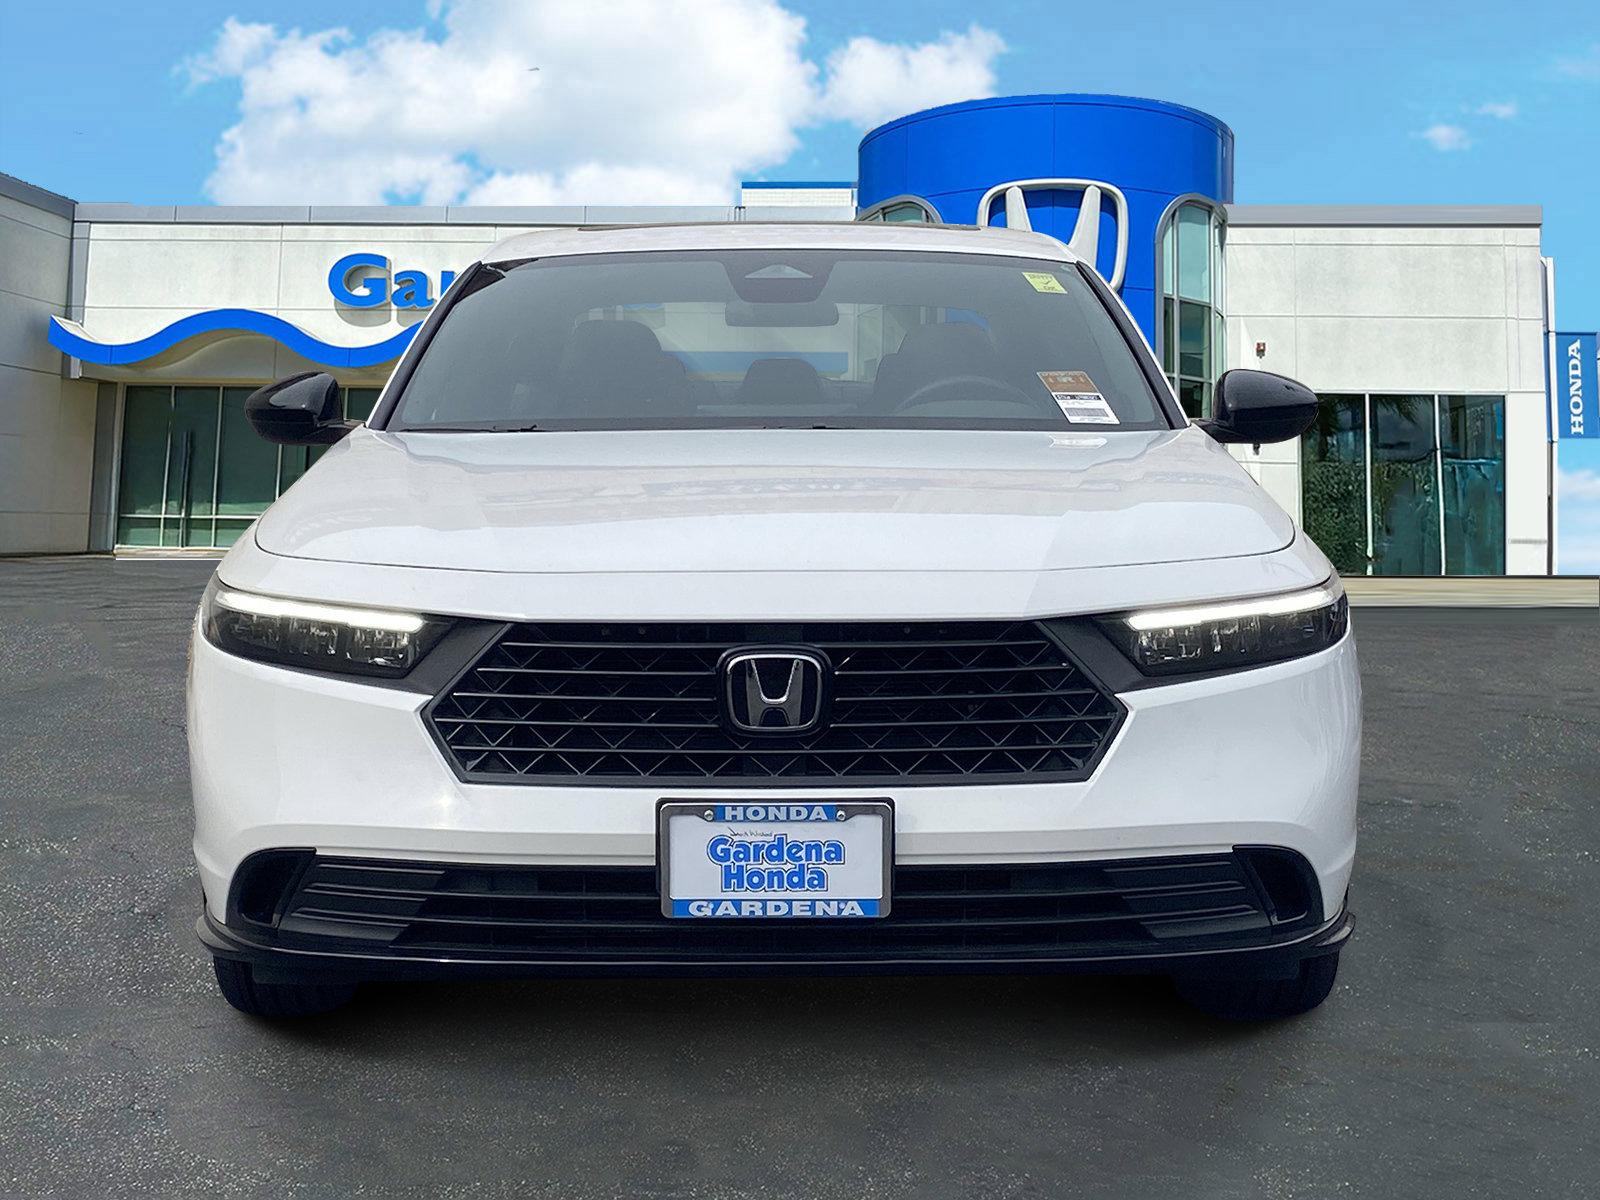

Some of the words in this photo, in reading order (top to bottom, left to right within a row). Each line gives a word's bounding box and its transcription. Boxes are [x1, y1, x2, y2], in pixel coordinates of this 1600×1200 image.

[1568, 339, 1584, 435] HONDA
[724, 806, 828, 820] HONDA
[708, 835, 844, 864] Gardena
[722, 863, 827, 891] Honda
[688, 901, 864, 917] GARDENA
